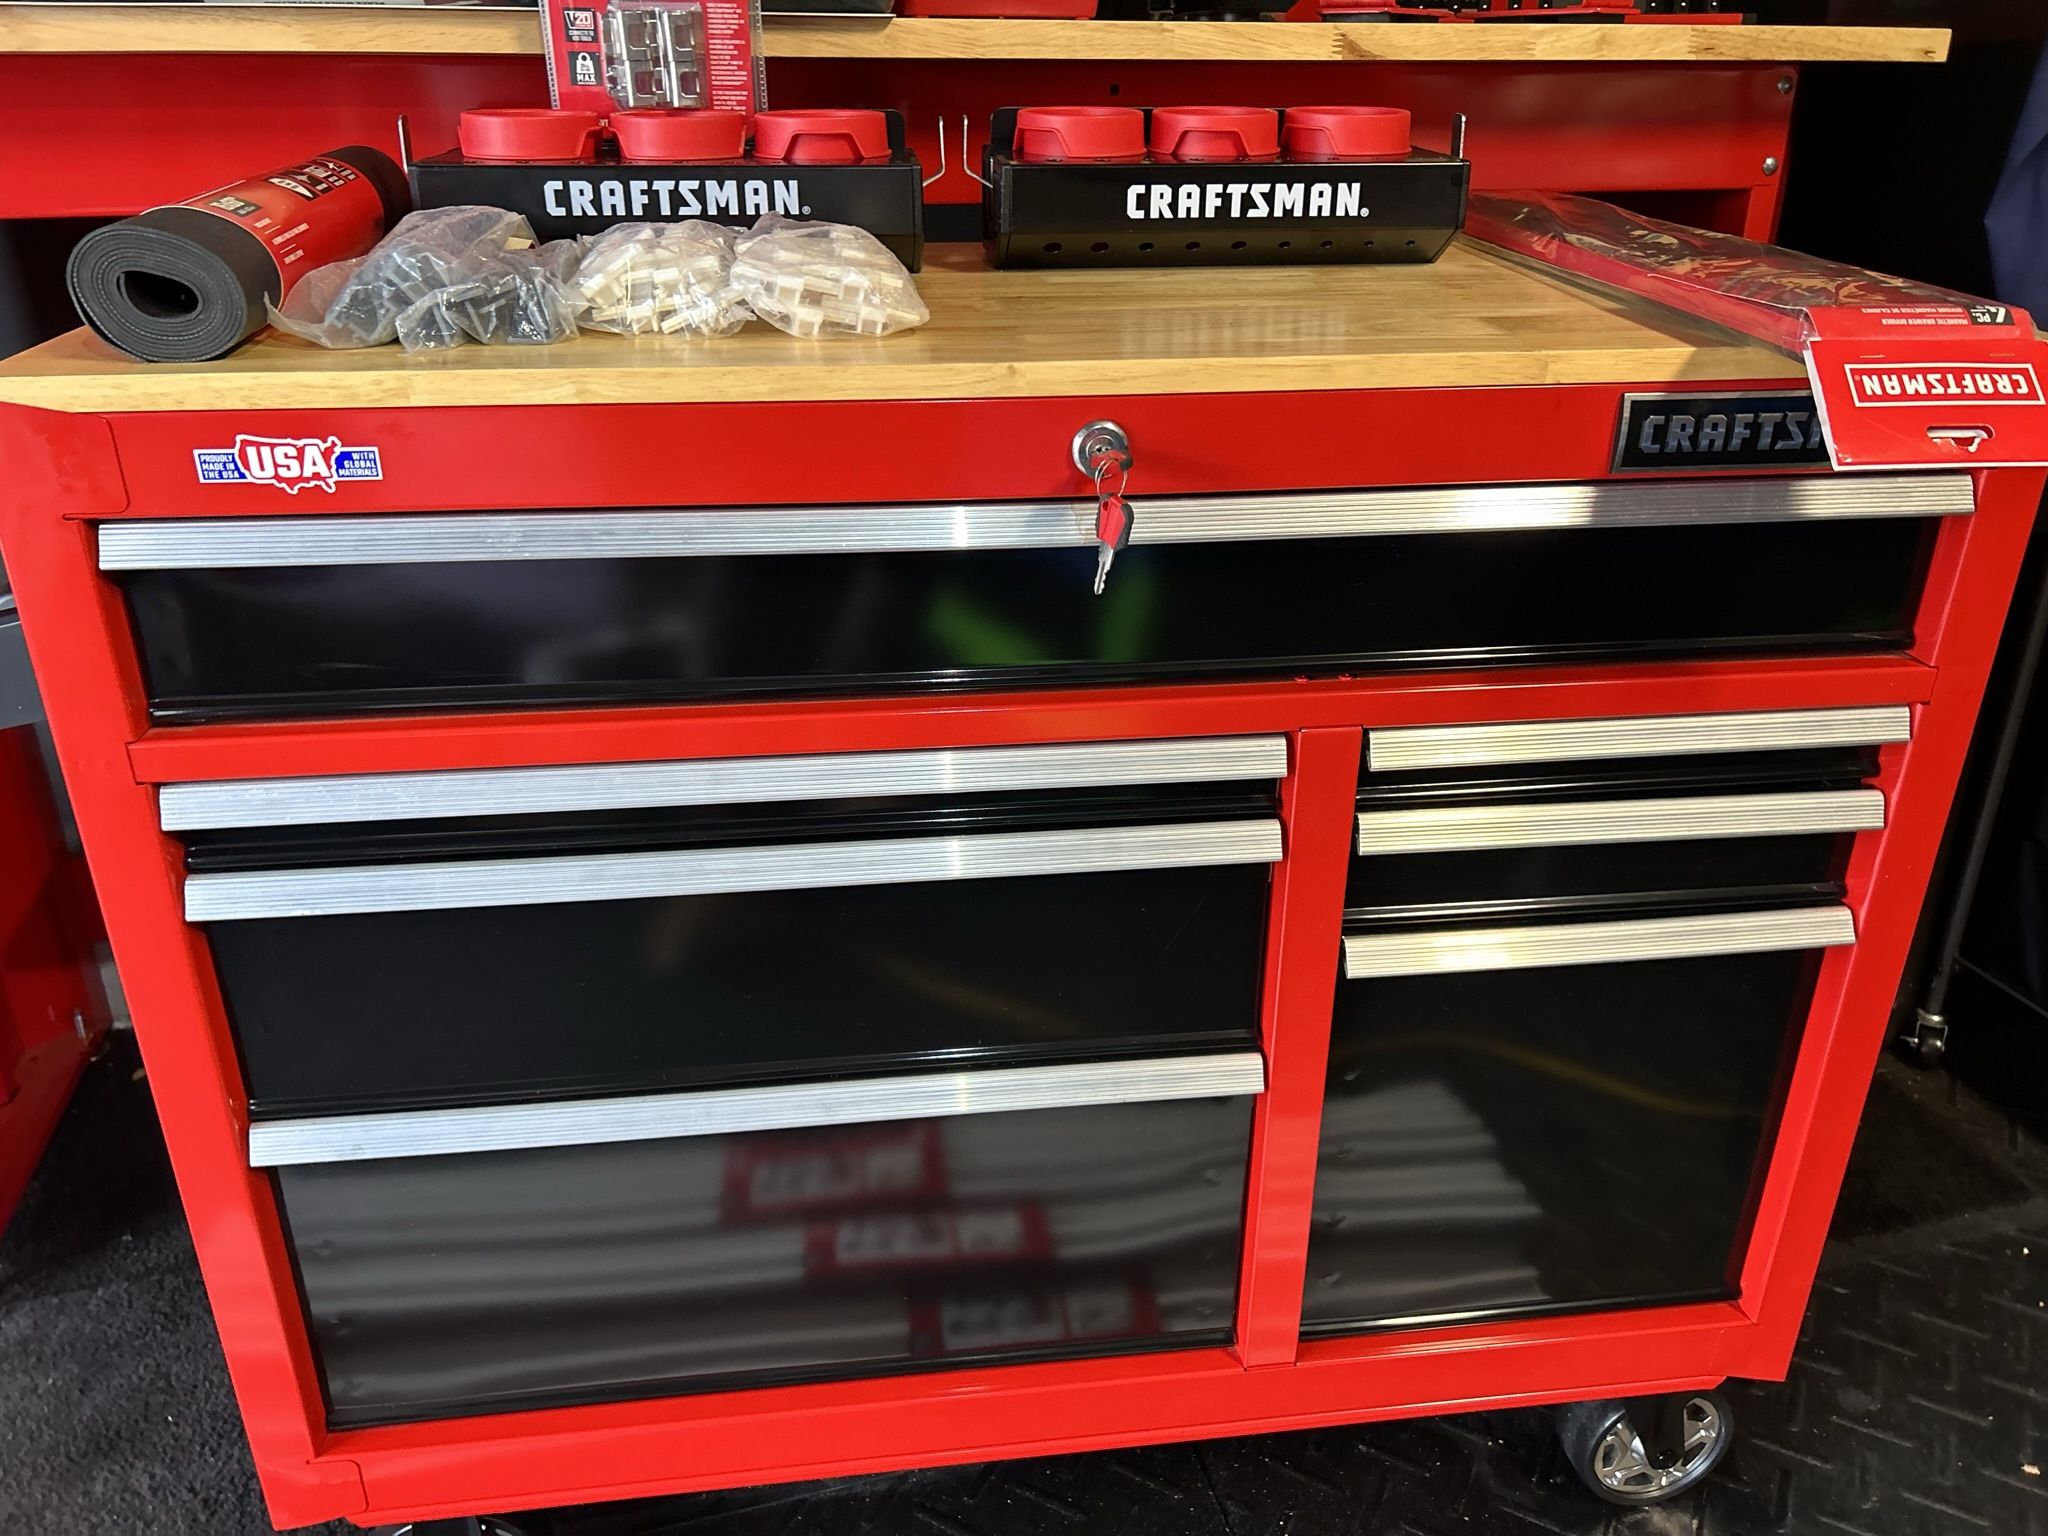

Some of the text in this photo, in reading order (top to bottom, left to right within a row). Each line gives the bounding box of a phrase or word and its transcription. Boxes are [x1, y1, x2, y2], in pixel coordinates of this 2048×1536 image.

[576, 74, 596, 83] MAX
[543, 180, 800, 217] CRAFTSMAN
[1126, 182, 1362, 220] CRAFTSMAN
[1861, 374, 2029, 395] CRAFTSMAN
[200, 454, 233, 463] PROUDLY
[352, 452, 375, 460] WITH
[245, 445, 332, 478] USA
[343, 460, 377, 469] GLOBAL
[202, 462, 236, 471] MADE IN
[203, 470, 240, 479] THE USA
[338, 468, 378, 477] MATERIALS
